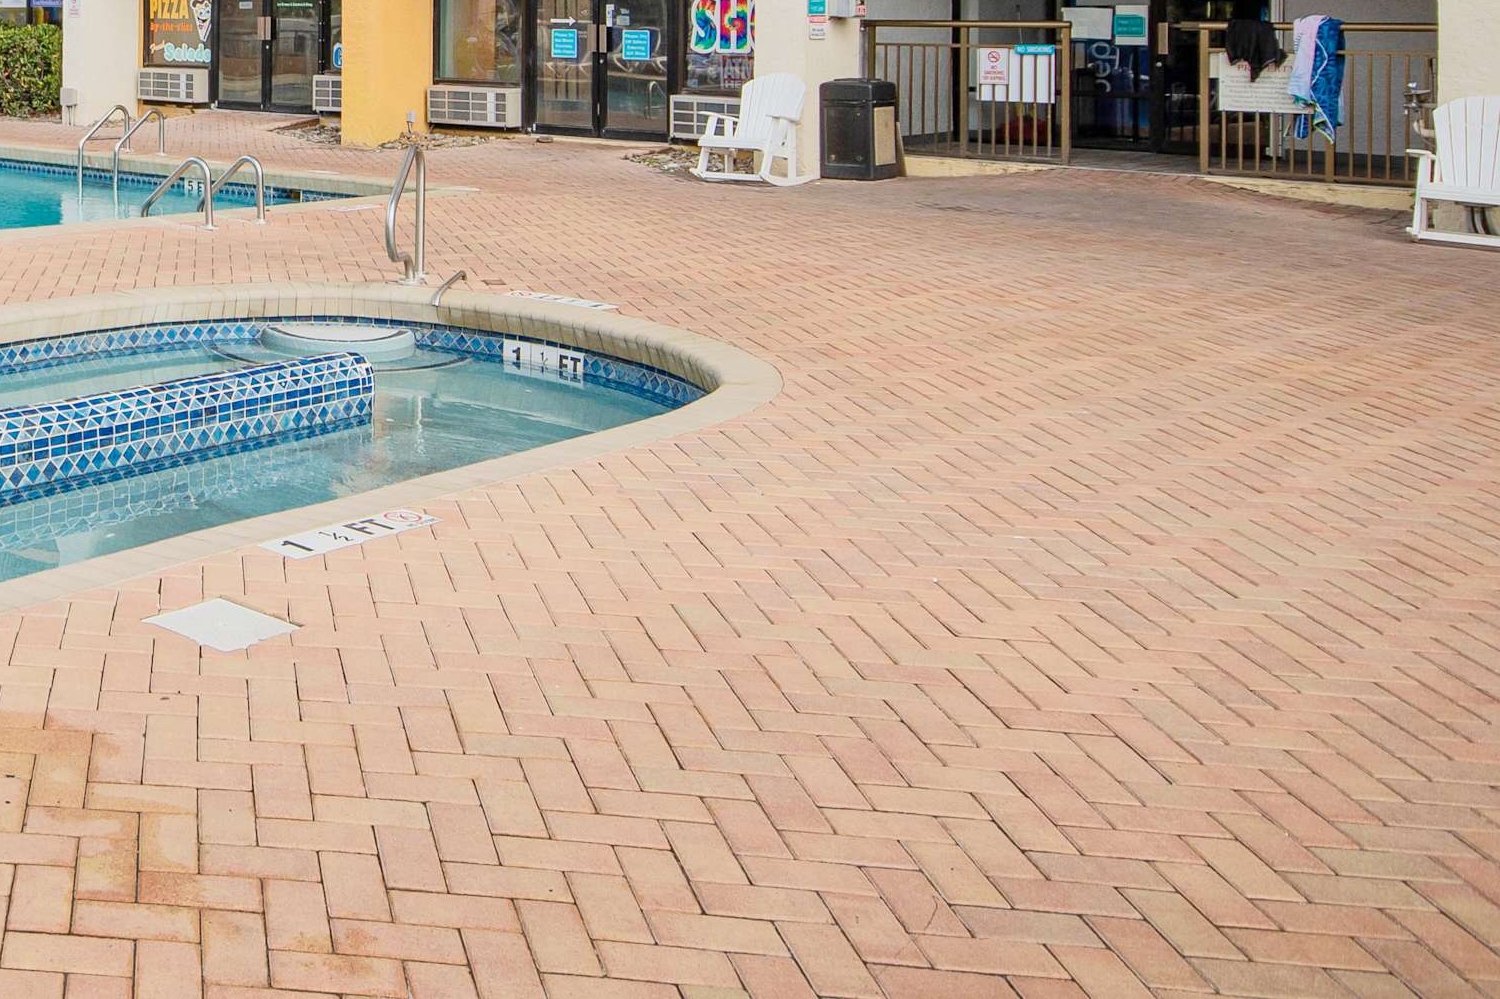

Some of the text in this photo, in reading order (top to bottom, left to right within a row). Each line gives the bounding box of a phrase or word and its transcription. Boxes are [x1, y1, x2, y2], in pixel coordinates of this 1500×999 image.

[164, 43, 211, 62] Salads
[188, 180, 194, 192] 5
[559, 354, 581, 373] FT
[342, 518, 395, 535] FT
